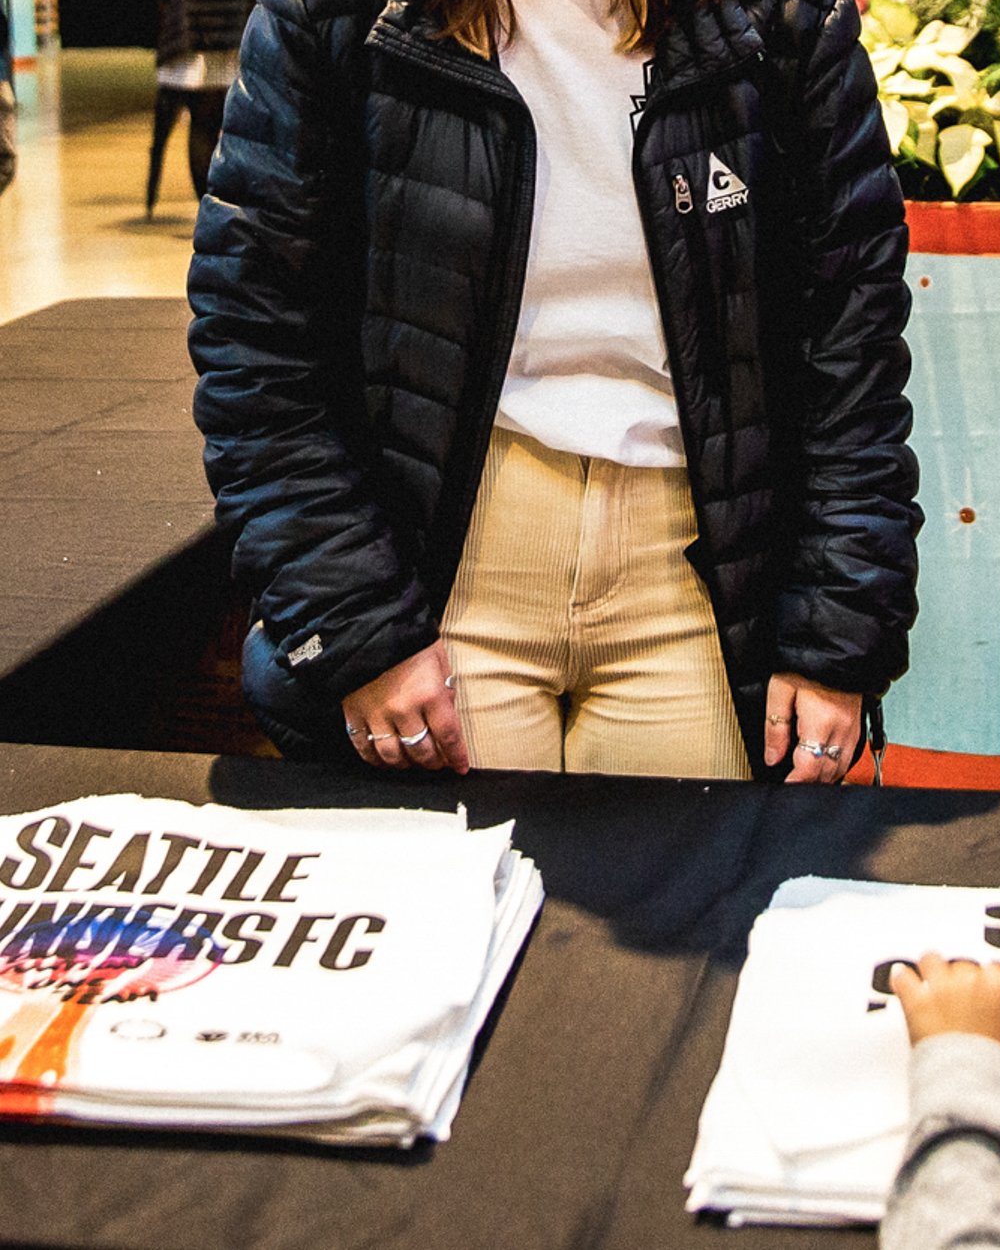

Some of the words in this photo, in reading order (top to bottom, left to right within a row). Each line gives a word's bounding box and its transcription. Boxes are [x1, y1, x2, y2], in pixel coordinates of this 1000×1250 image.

[705, 189, 750, 214] GERRY
[0, 816, 322, 903] SEATTLE
[273, 913, 386, 971] FC
